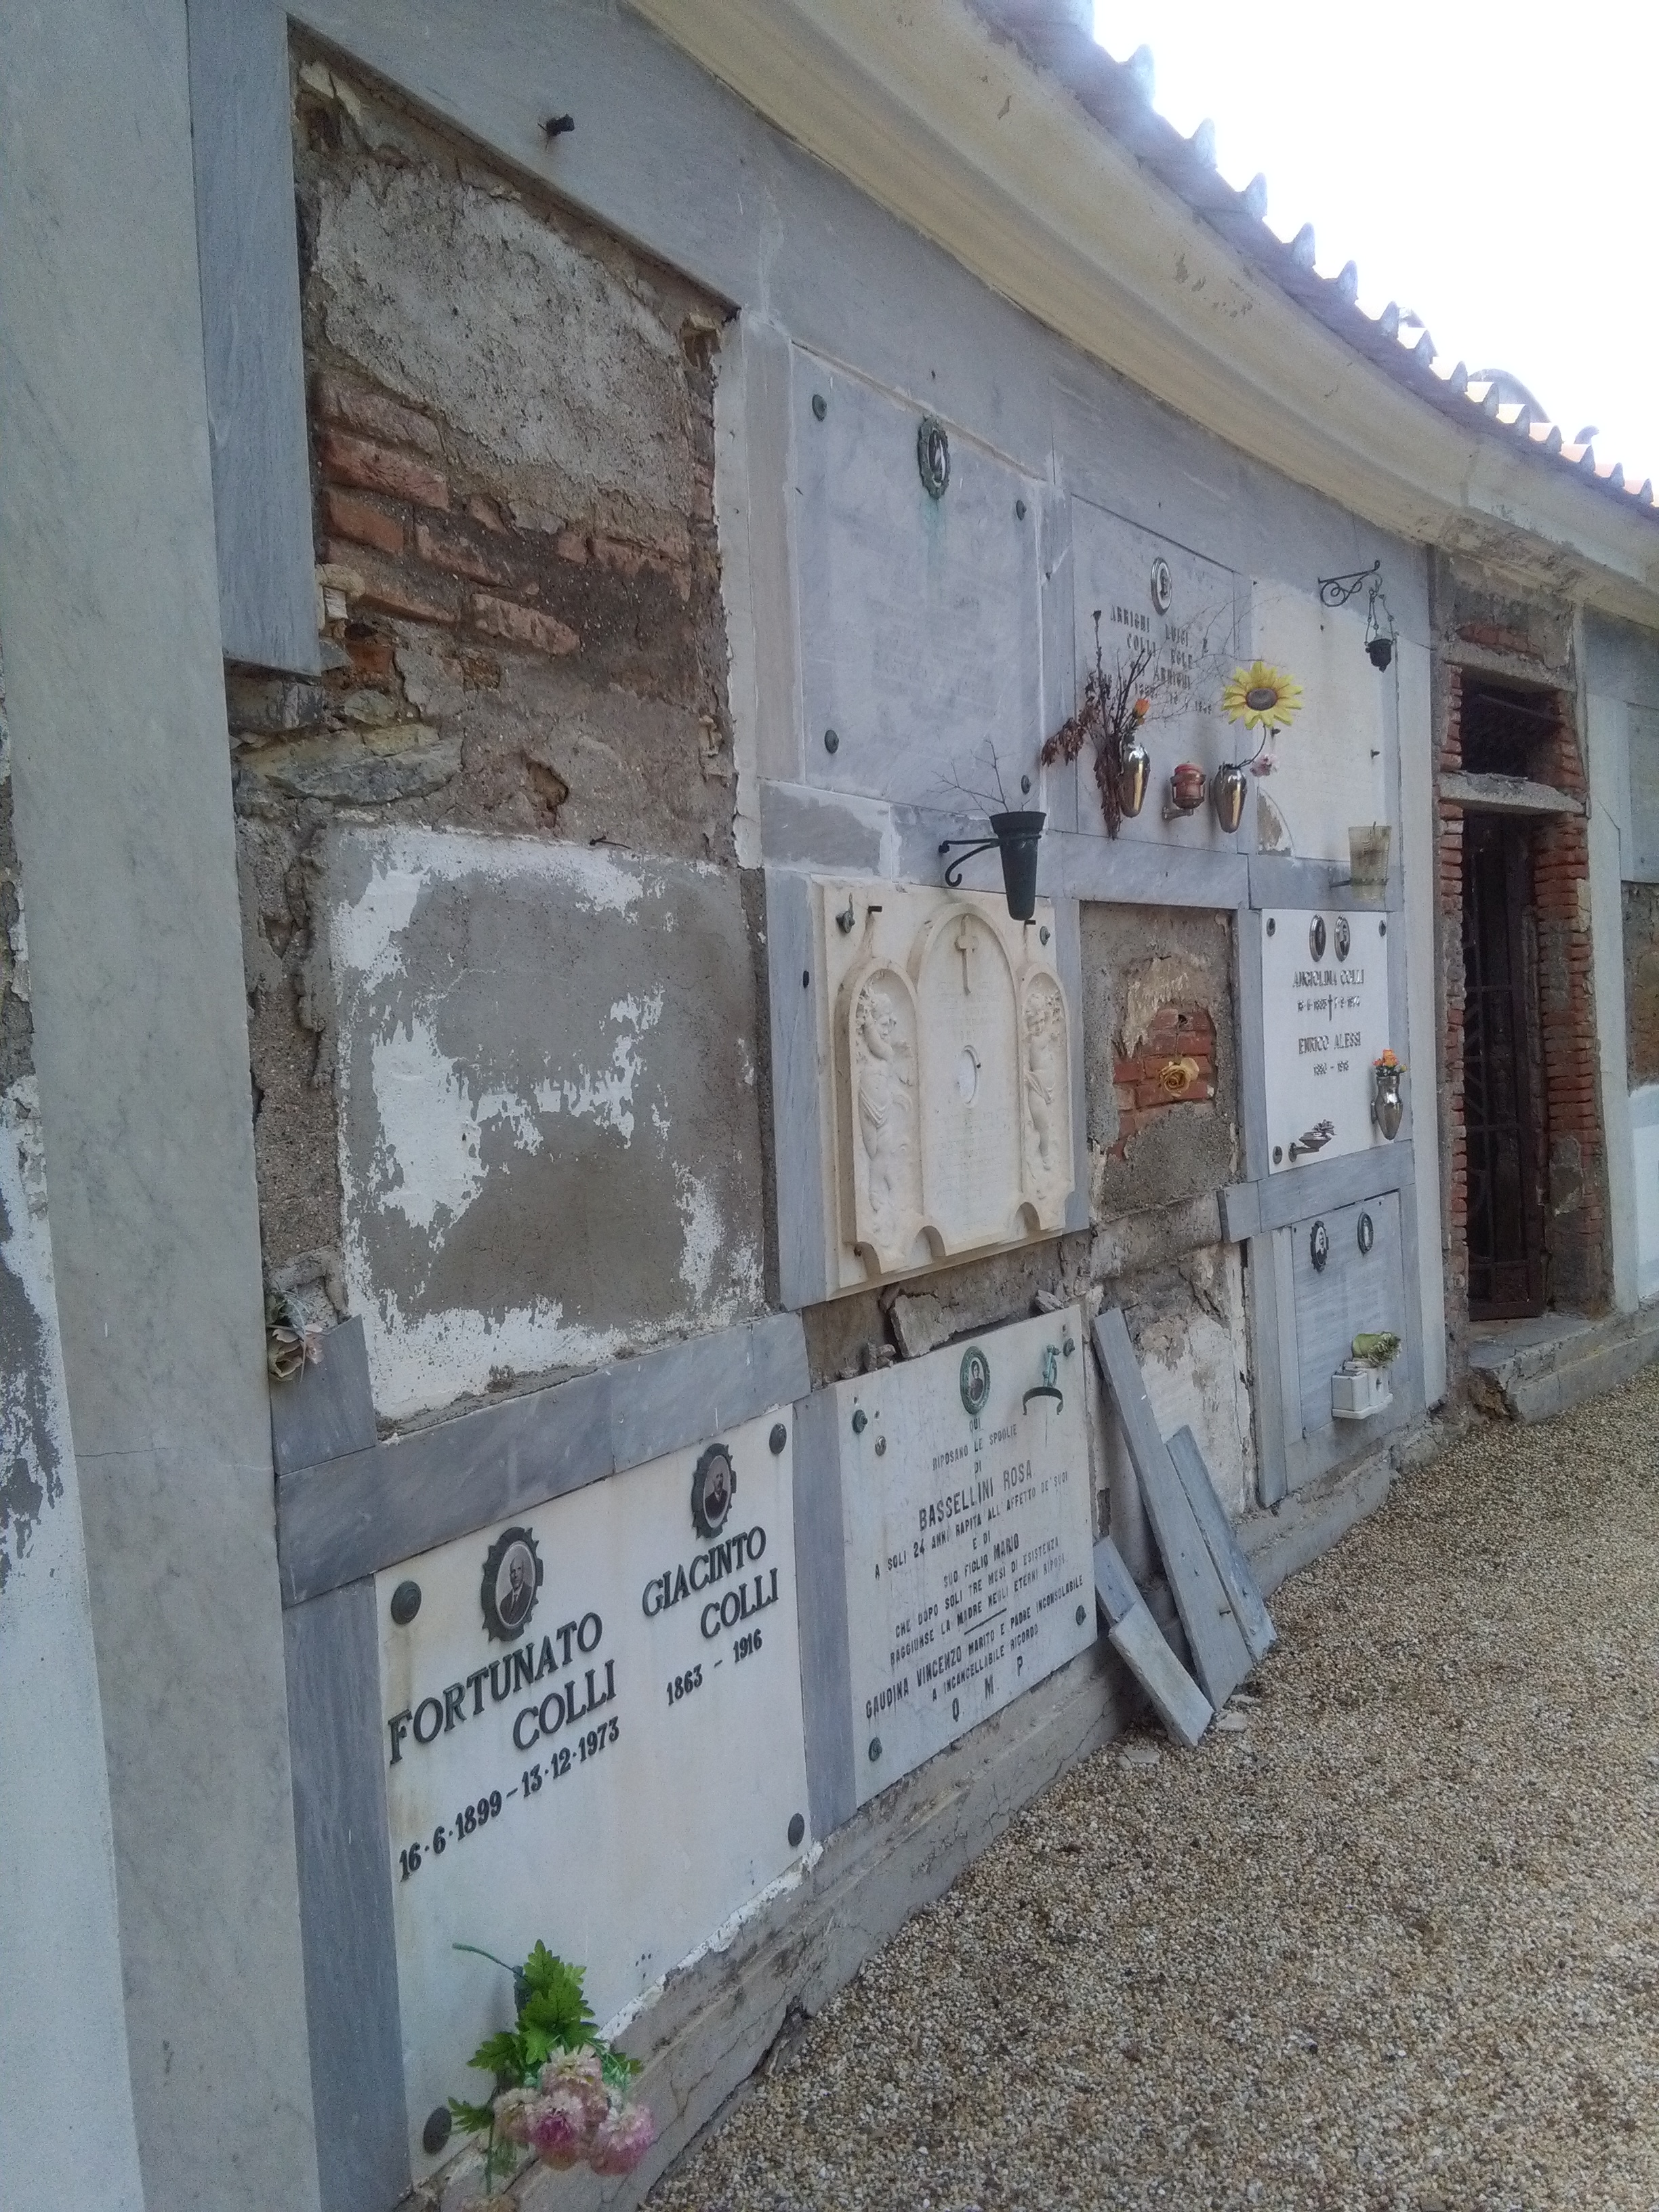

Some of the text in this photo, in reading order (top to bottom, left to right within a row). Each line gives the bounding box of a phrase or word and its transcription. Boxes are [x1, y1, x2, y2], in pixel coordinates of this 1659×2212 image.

[1292, 969, 1364, 987] ANGIOLINA COLLI
[1298, 1031, 1361, 1054] ENRICO ALESSI
[933, 1444, 968, 1471] RIPOSANO
[974, 1438, 983, 1452] LE
[969, 1417, 981, 1432] QUI
[919, 1459, 1032, 1532] BASSELLINI ROSA
[974, 1460, 981, 1473] DI
[642, 1526, 766, 1617] GIACINTO
[875, 1563, 880, 1580] A
[887, 1550, 907, 1571] SOLI
[914, 1538, 925, 1558] 24
[931, 1529, 949, 1549] ANNI
[956, 1513, 981, 1537] RAPITA
[943, 1532, 1019, 1588] SUO FIGLIO MARIO
[972, 1530, 990, 1551] E DI
[701, 1568, 779, 1639] COLLI
[890, 1553, 1065, 1668] RAGGIUNSE LA MADRE NEGLI ETERNI RIPOSI
[895, 1536, 1059, 1638] CHE DOPO SOLI TRE MESI DI ESISTENZA
[667, 1664, 703, 1706] 1863
[733, 1629, 762, 1662] 1916
[865, 1575, 1083, 1719] GAUDINA VINCENZO MARITO E PADRE INCONSOLABILE
[933, 1624, 1038, 1702] A INCANCELLABILE RICORDO
[388, 1612, 602, 1765] FORTUNATO
[513, 1659, 617, 1750] COLLI
